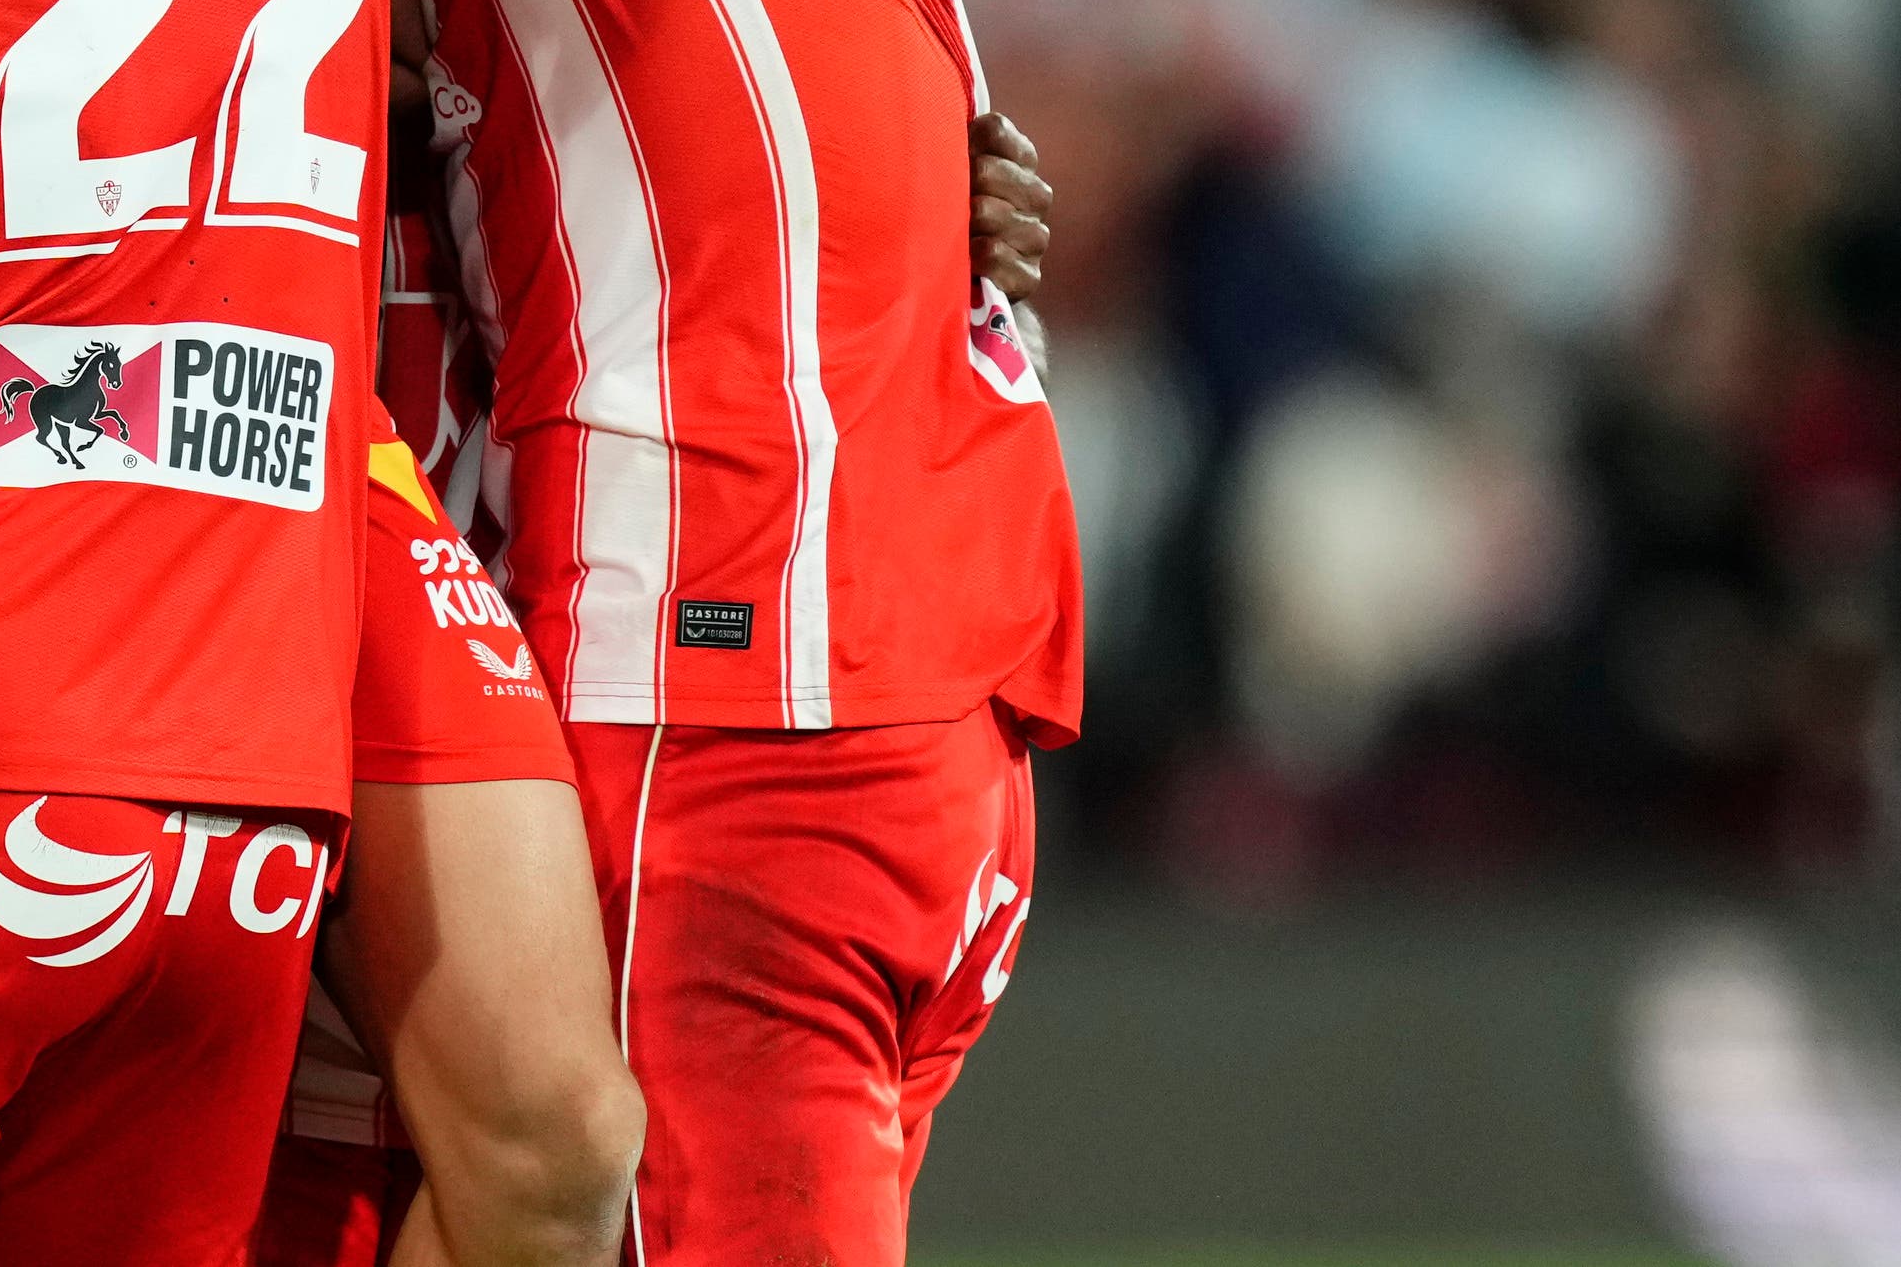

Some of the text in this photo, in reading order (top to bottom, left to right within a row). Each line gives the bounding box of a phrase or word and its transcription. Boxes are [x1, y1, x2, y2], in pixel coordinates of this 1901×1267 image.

[173, 339, 323, 423] POWER
[169, 406, 315, 492] HORSE
[424, 579, 522, 634] KUD
[686, 609, 745, 621] CASTORE
[483, 684, 544, 701] CASTORE
[162, 810, 329, 939] TC
